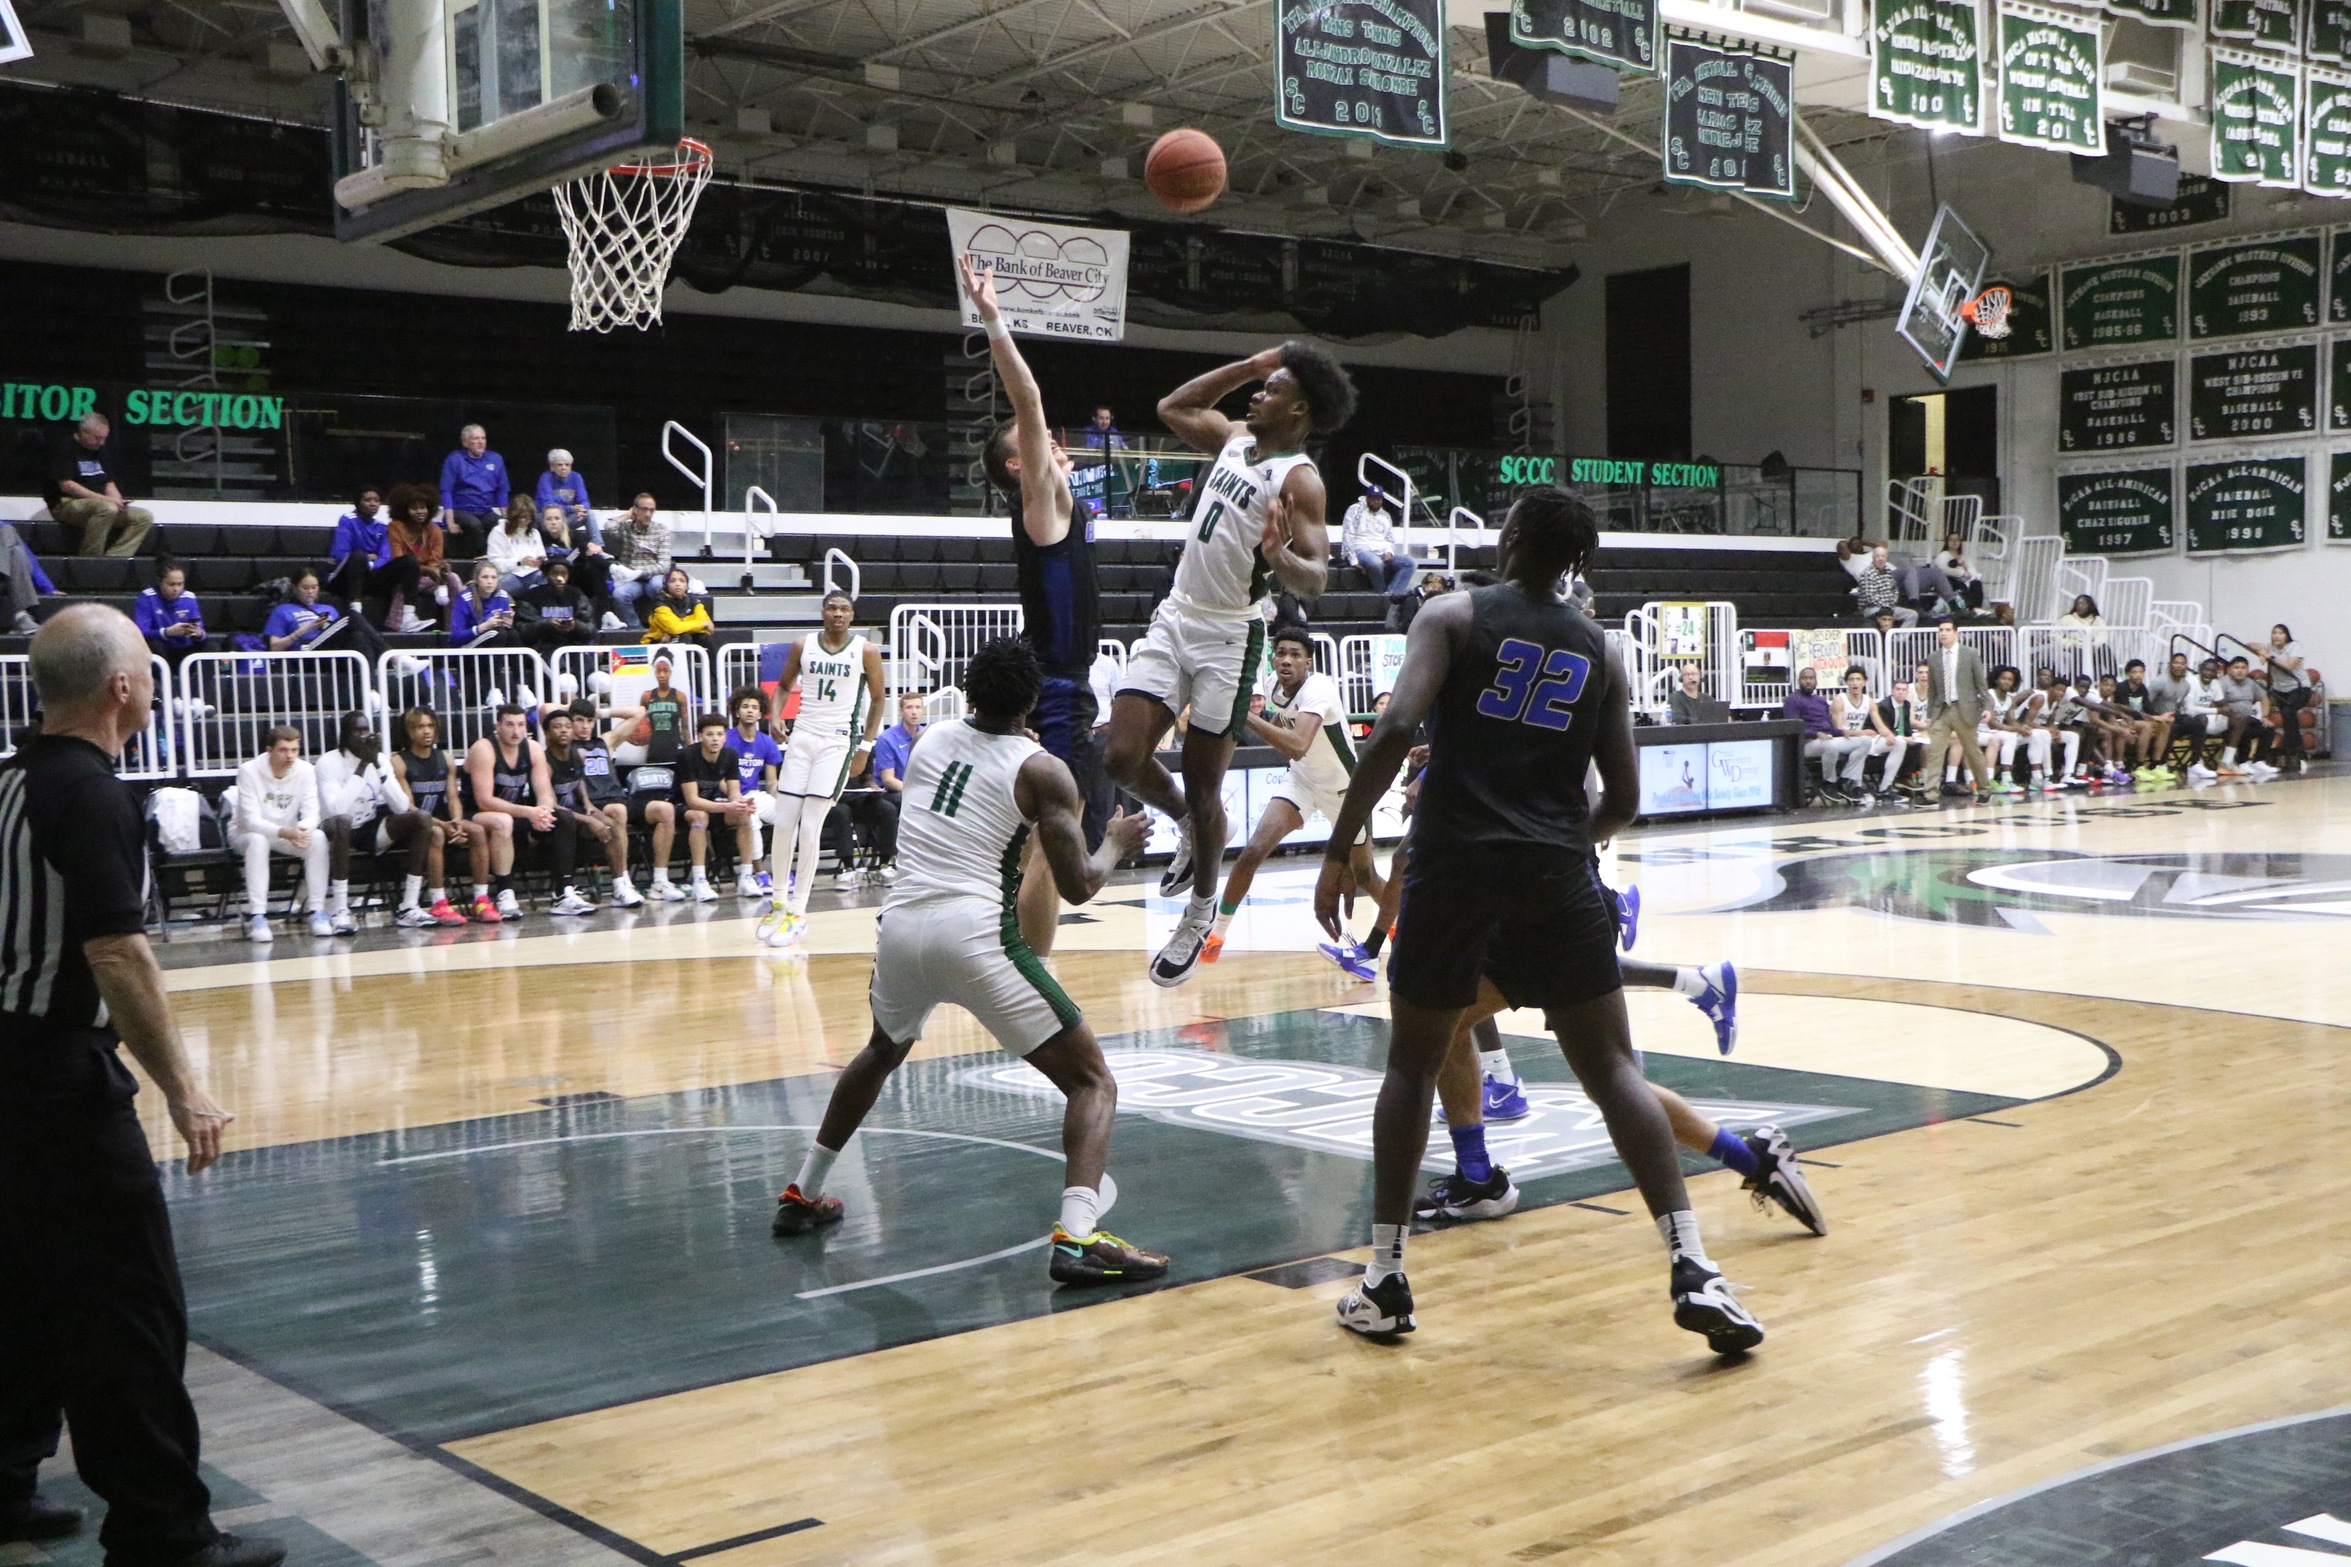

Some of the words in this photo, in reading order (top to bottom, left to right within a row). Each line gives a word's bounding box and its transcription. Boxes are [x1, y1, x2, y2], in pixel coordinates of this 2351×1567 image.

[1282, 6, 1308, 34] ITA
[969, 254, 992, 268] The
[996, 257, 1027, 275] Bank
[1030, 262, 1043, 276] of
[1045, 265, 1083, 283] Beaver
[1085, 268, 1109, 284] City
[2093, 289, 2145, 304] CHAMPIONS
[2228, 291, 2280, 306] BASEBALL
[2094, 307, 2143, 321] BASEBALL
[1013, 319, 1029, 329] KS
[1046, 322, 1093, 336] BEAVER,
[1095, 326, 1113, 337] OK
[2227, 354, 2279, 371] NJCAA
[2093, 369, 2140, 385] NJCAA
[2203, 376, 2231, 388] WEST
[2073, 391, 2095, 402] WEST
[2152, 385, 2163, 394] VI
[2225, 382, 2280, 397] CHAMPIONS
[0, 383, 97, 421] ITOR
[125, 389, 284, 429] SECTION
[2090, 397, 2142, 411] CHAMPIONS
[2221, 400, 2284, 415] BASEBALL
[2087, 413, 2146, 427] BASEBALL
[2231, 417, 2273, 432] 2000
[1500, 455, 1554, 484] SCCC
[1572, 458, 1644, 484] STUDENT
[1651, 462, 1718, 487] SECTION
[1208, 467, 1257, 510] SAINTS
[2188, 473, 2223, 503] NJCAA
[2088, 498, 2141, 511] BASEBALL
[1197, 501, 1225, 544] 0
[2077, 517, 2106, 528] CHAZ
[2098, 533, 2133, 546] 1997
[809, 661, 851, 677] SAINTS
[817, 678, 836, 702] 14
[1476, 638, 1590, 731] 32
[584, 758, 609, 776] 20
[929, 760, 974, 818] 11
